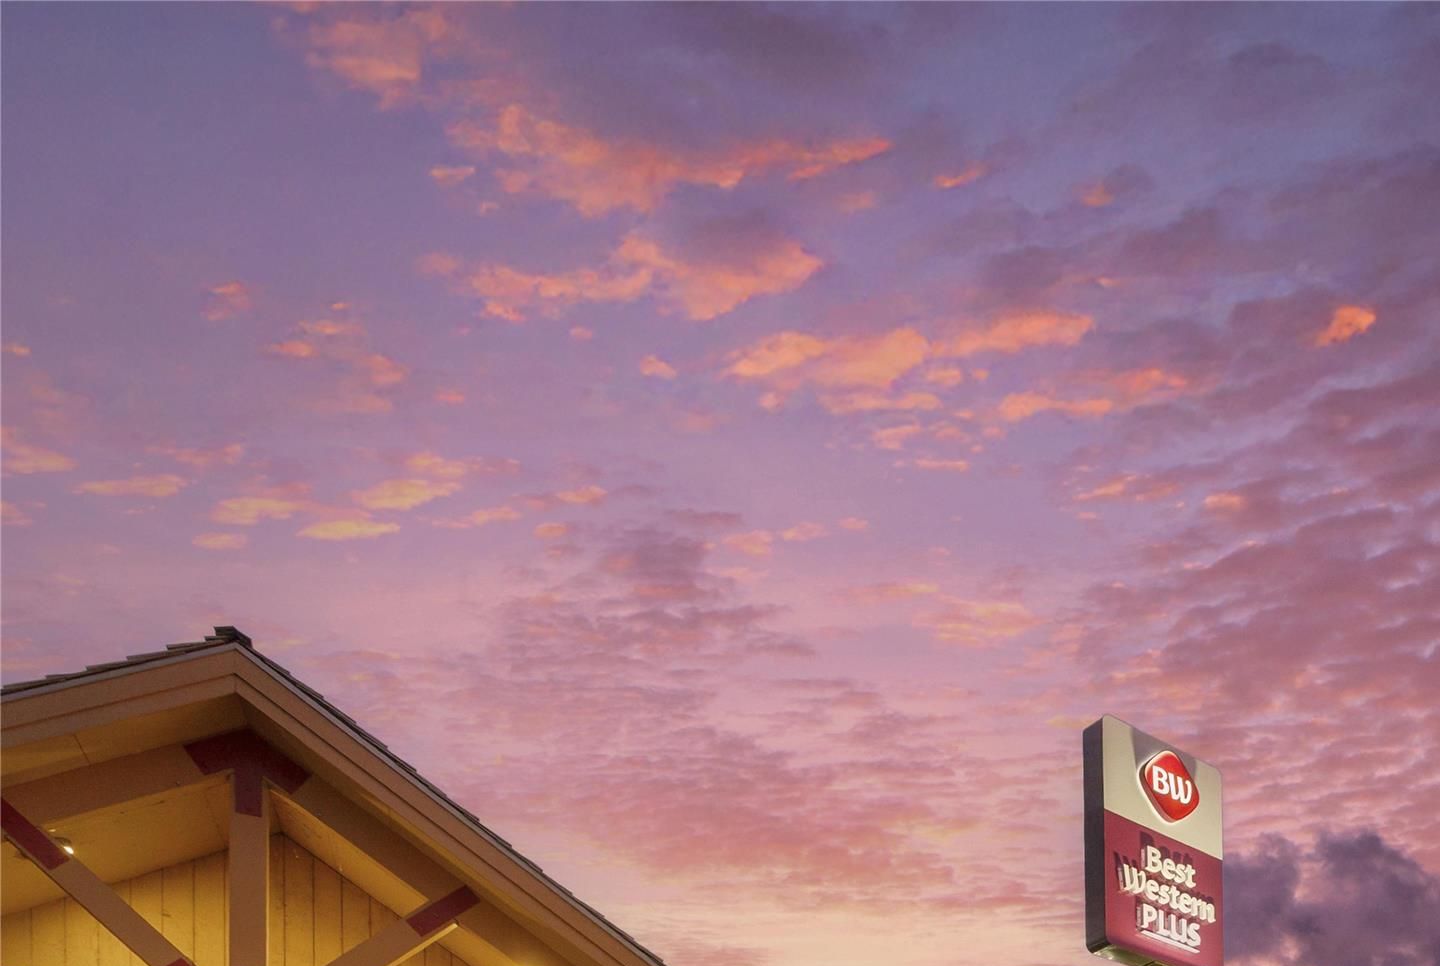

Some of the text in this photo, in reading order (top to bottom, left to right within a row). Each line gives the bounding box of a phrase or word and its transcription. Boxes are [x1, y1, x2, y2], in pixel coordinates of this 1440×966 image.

[1152, 765, 1192, 805] BW
[1145, 845, 1196, 888] Best
[1121, 863, 1216, 923] Western
[1140, 903, 1201, 947] PLUS
